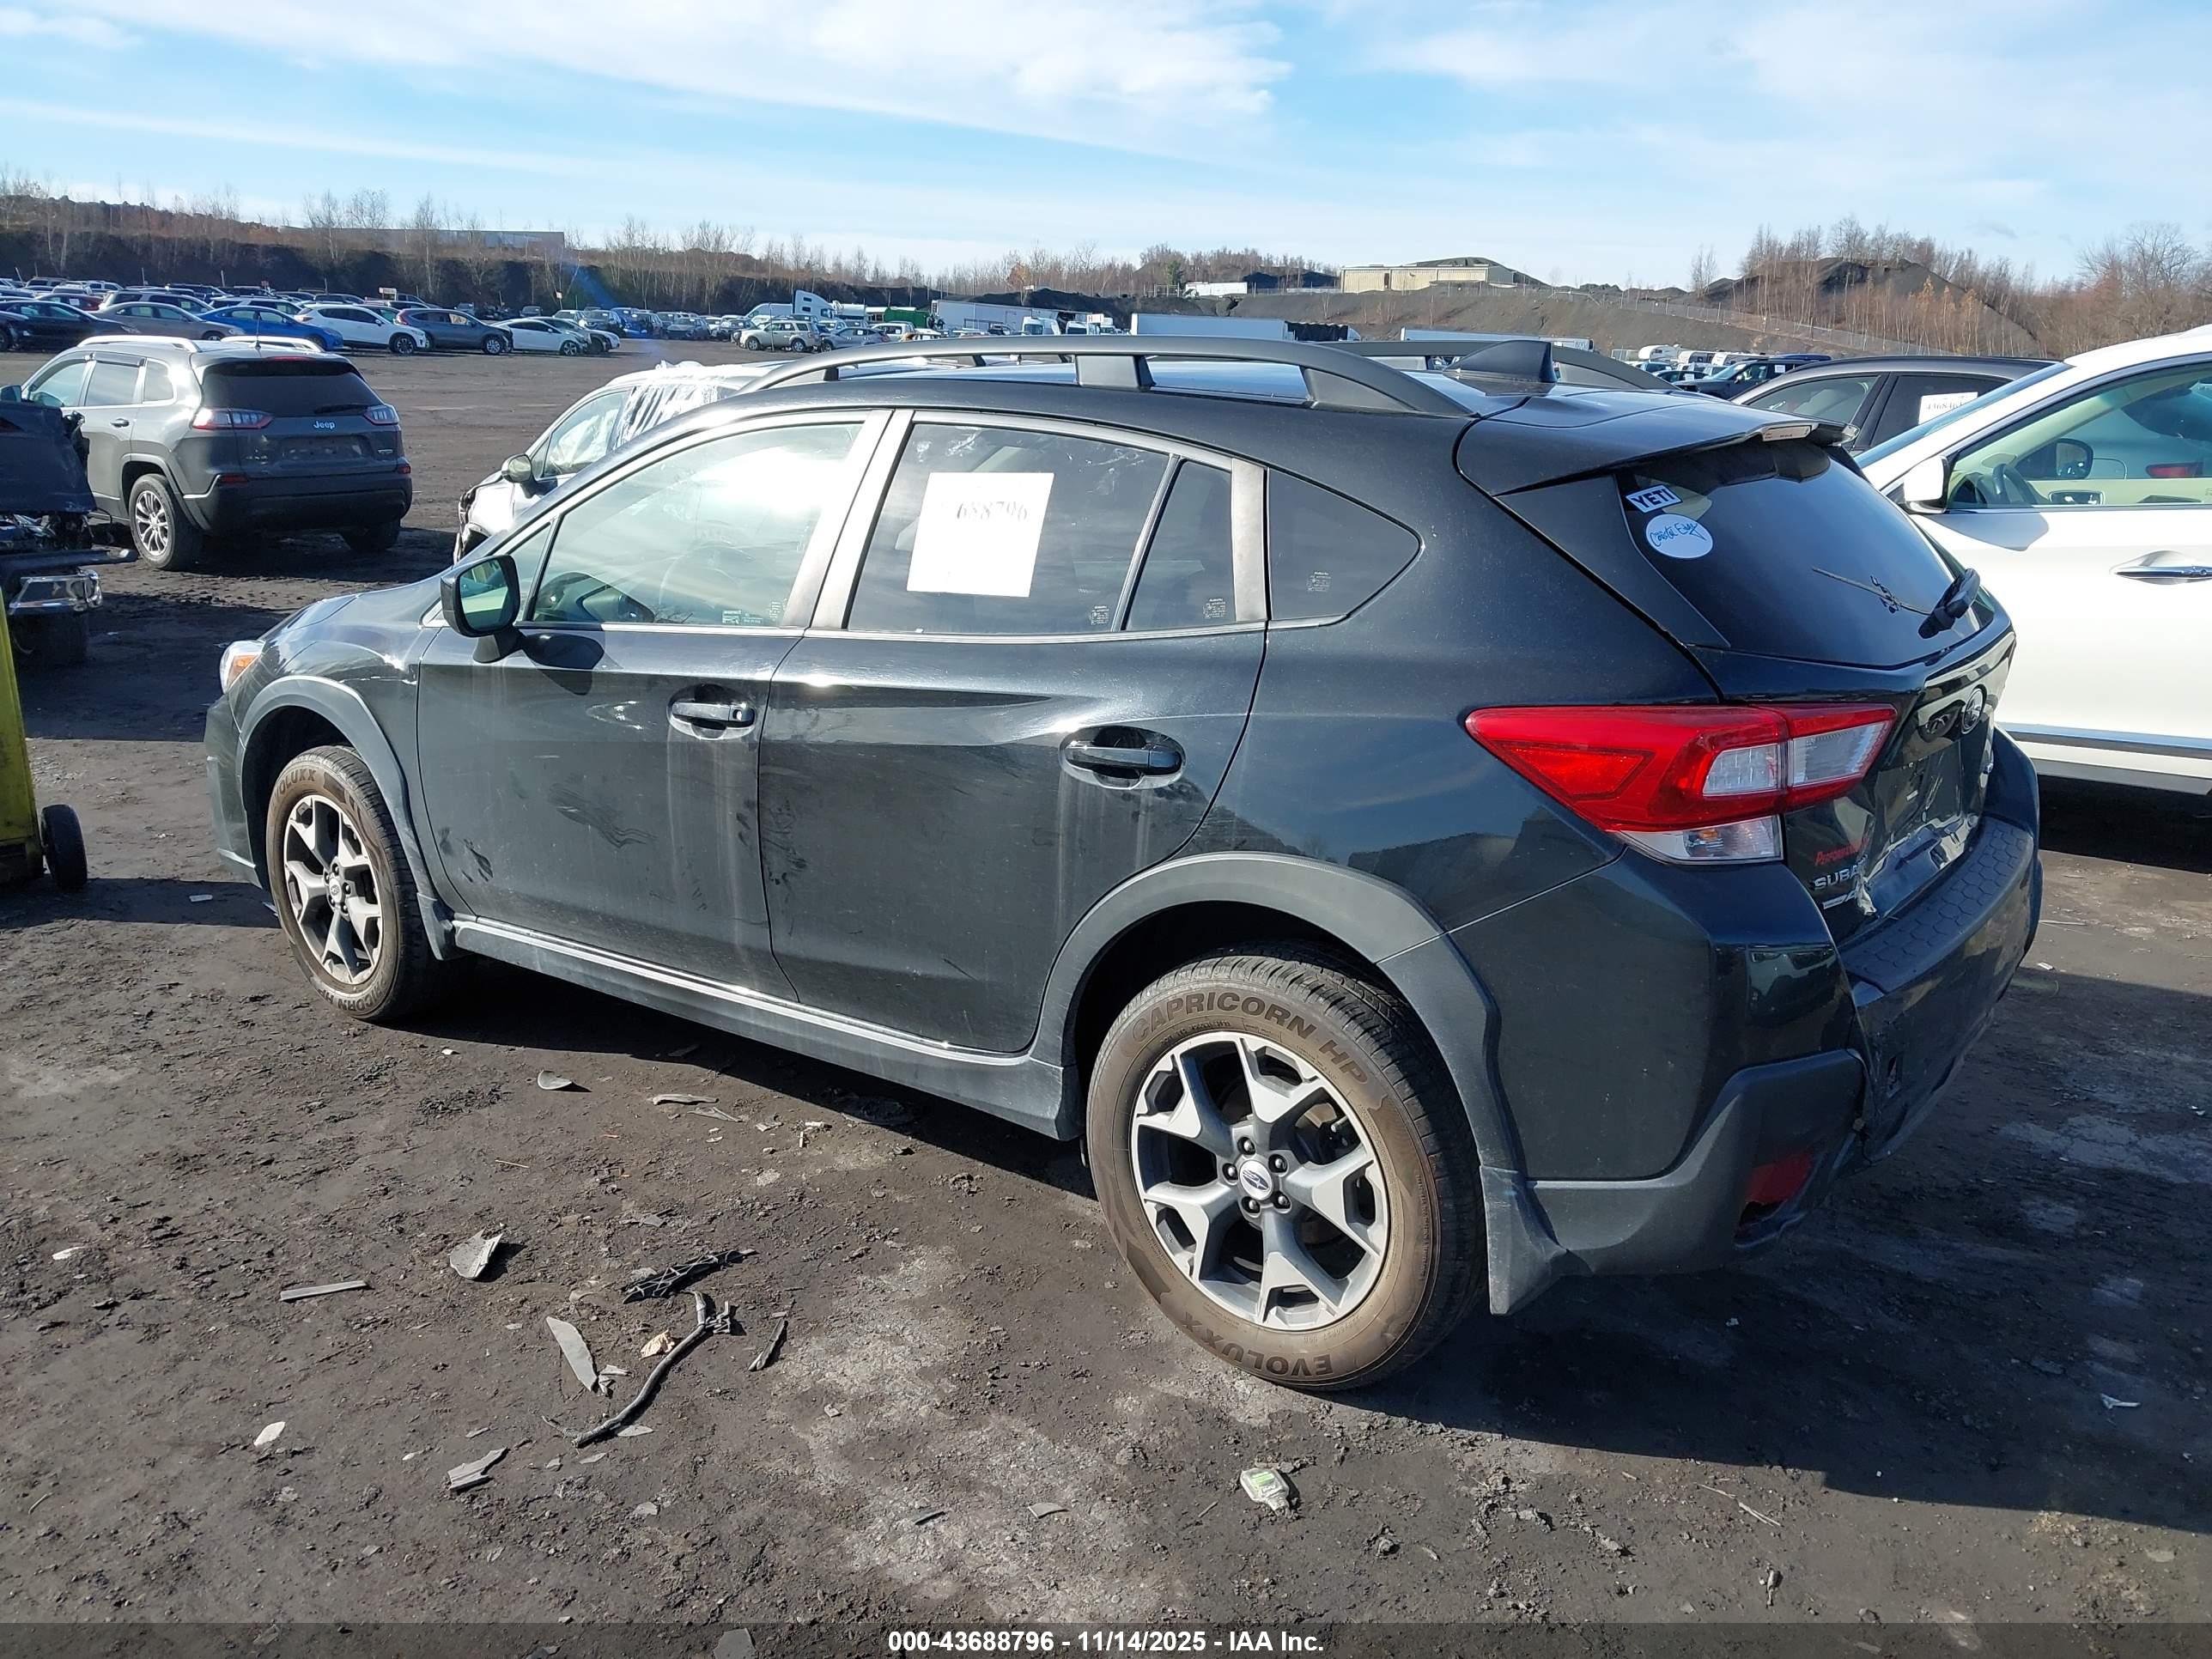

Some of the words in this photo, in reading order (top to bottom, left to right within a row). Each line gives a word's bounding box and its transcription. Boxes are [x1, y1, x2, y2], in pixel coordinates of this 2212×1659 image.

[313, 420, 336, 429] Jeep
[1632, 489, 1675, 508] YETI
[1132, 992, 1316, 1043] CAPRICORN
[1319, 1040, 1368, 1085] HP
[1181, 1312, 1334, 1376] EVOLUXX
